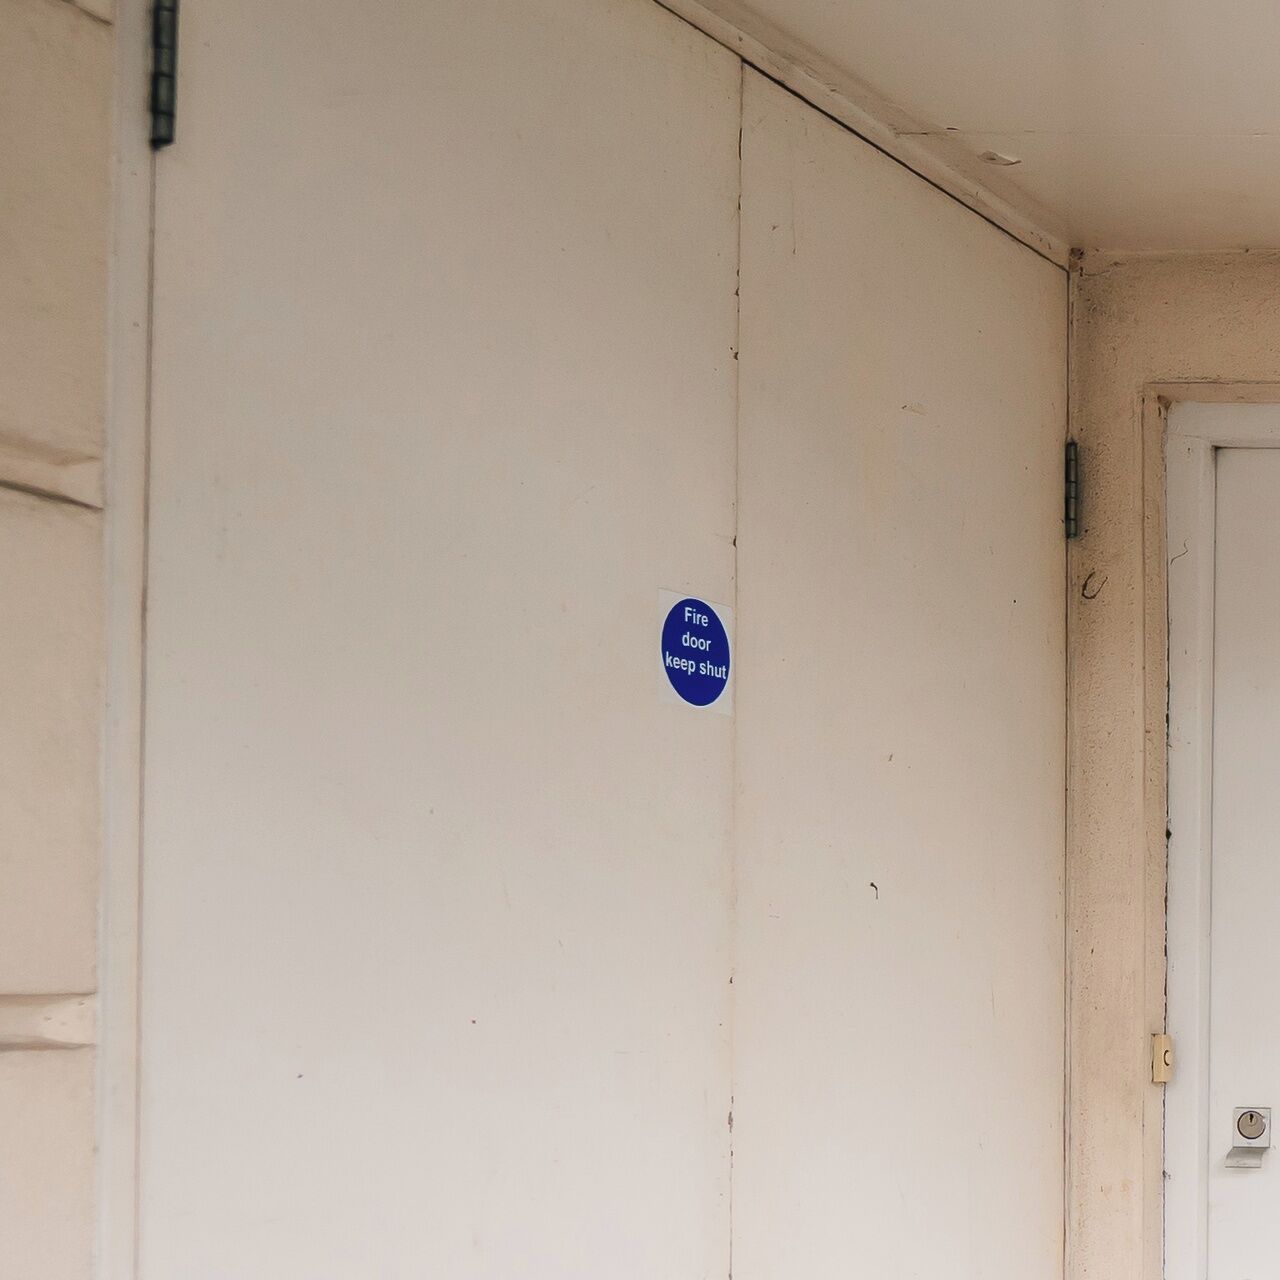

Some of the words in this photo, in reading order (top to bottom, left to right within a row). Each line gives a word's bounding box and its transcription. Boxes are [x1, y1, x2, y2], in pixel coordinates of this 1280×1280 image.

[684, 607, 709, 627] Fire
[682, 631, 712, 652] door
[665, 651, 696, 675] keep
[699, 660, 727, 680] shut
